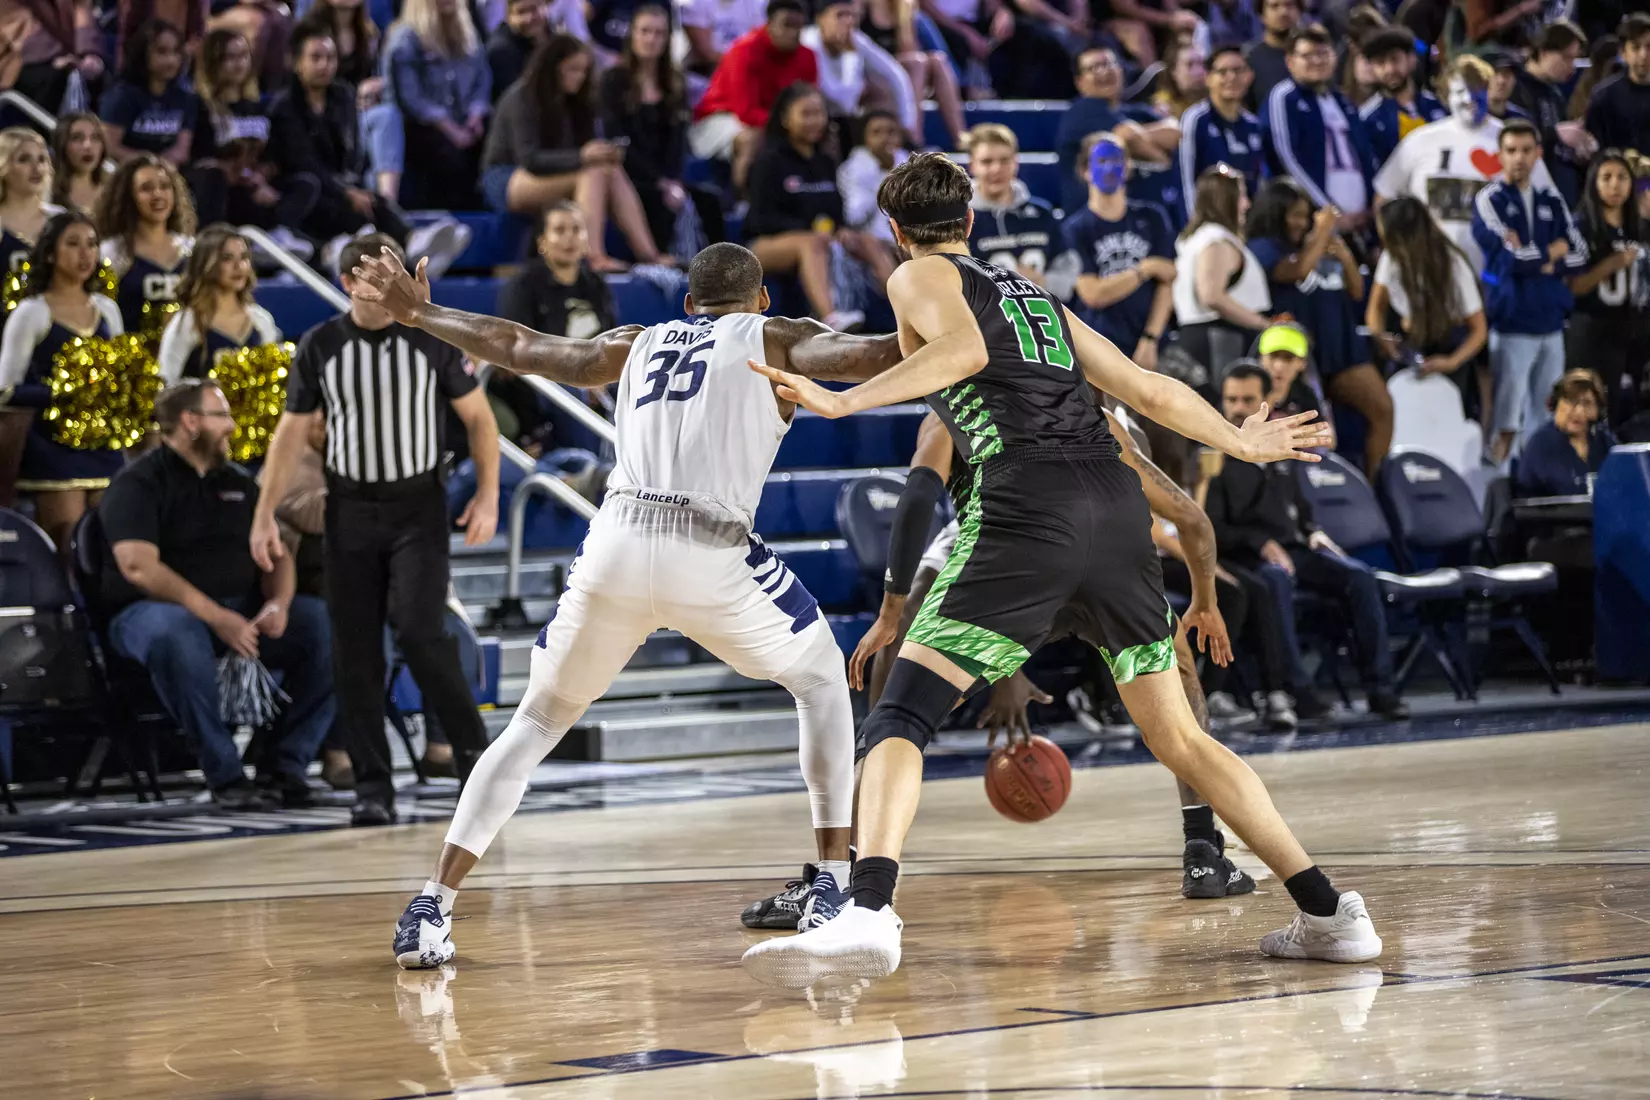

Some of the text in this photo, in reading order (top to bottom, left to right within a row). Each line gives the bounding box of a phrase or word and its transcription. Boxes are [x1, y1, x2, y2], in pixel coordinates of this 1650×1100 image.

[996, 280, 1041, 297] RLEY
[662, 325, 715, 345] DAVIS
[999, 295, 1074, 372] 13
[635, 339, 716, 410] 35
[636, 489, 690, 507] LanceUp
